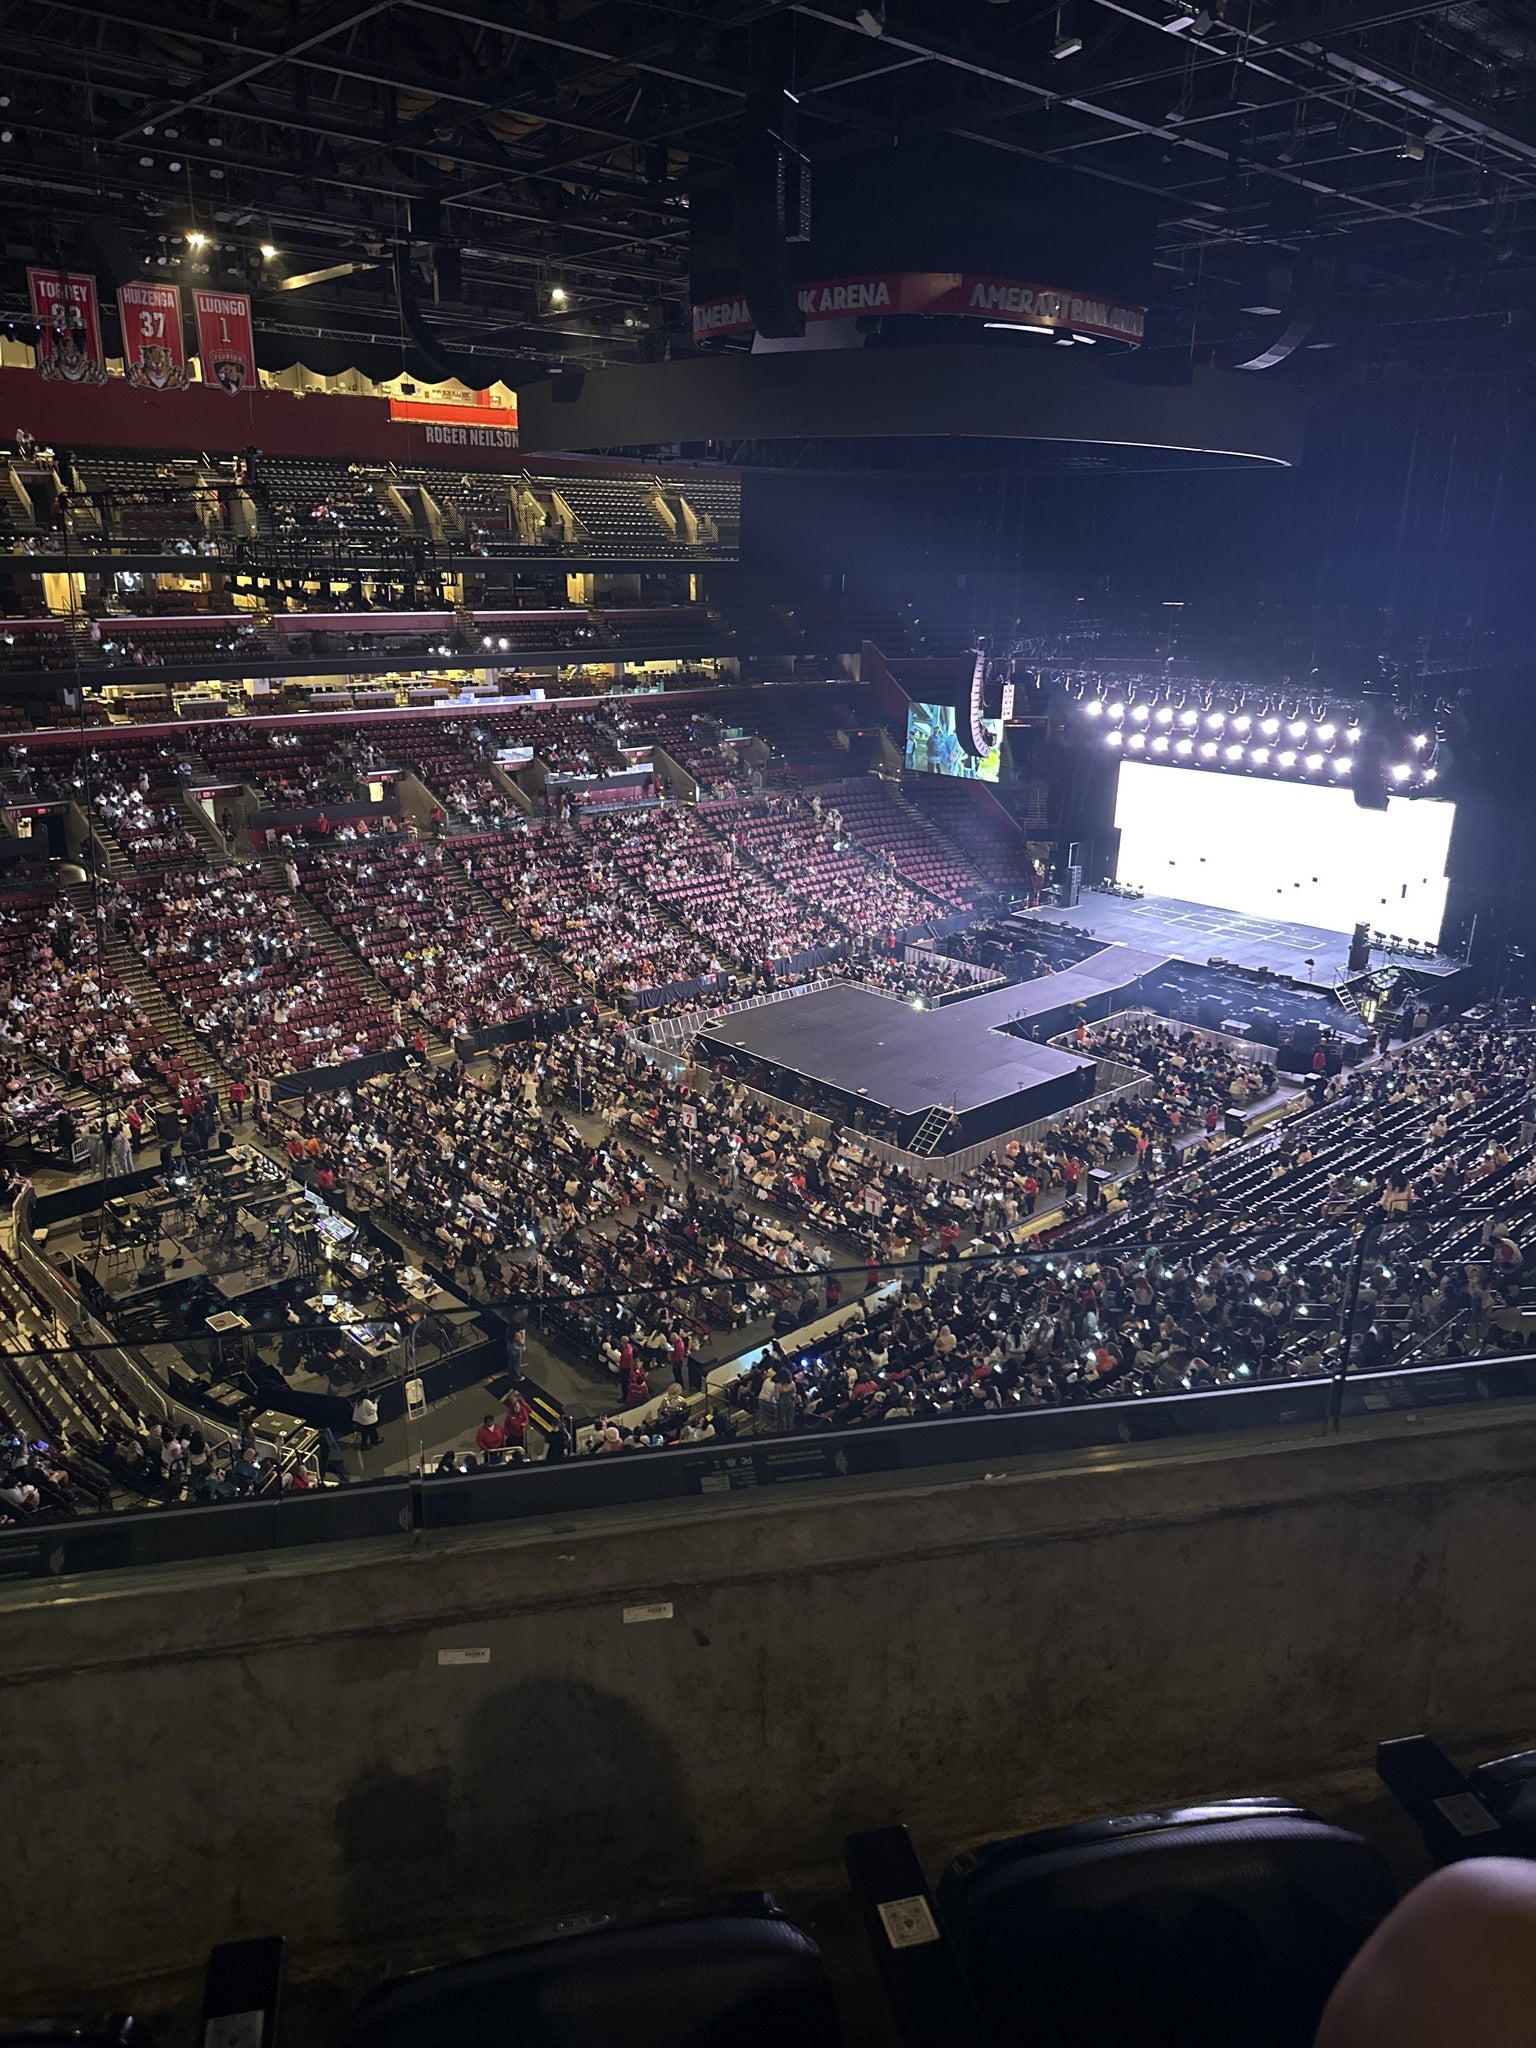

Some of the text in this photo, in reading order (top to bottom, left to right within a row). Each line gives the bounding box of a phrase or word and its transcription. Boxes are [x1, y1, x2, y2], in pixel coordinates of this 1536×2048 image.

[123, 288, 175, 308] HUIZENGA
[200, 297, 246, 316] LUONGO
[819, 282, 891, 312] ARENA
[968, 283, 1072, 319] AMERANT
[1071, 298, 1109, 326] BANK
[139, 311, 166, 338] 37
[220, 317, 231, 343] 1
[425, 426, 519, 448] ROGER NEILSON
